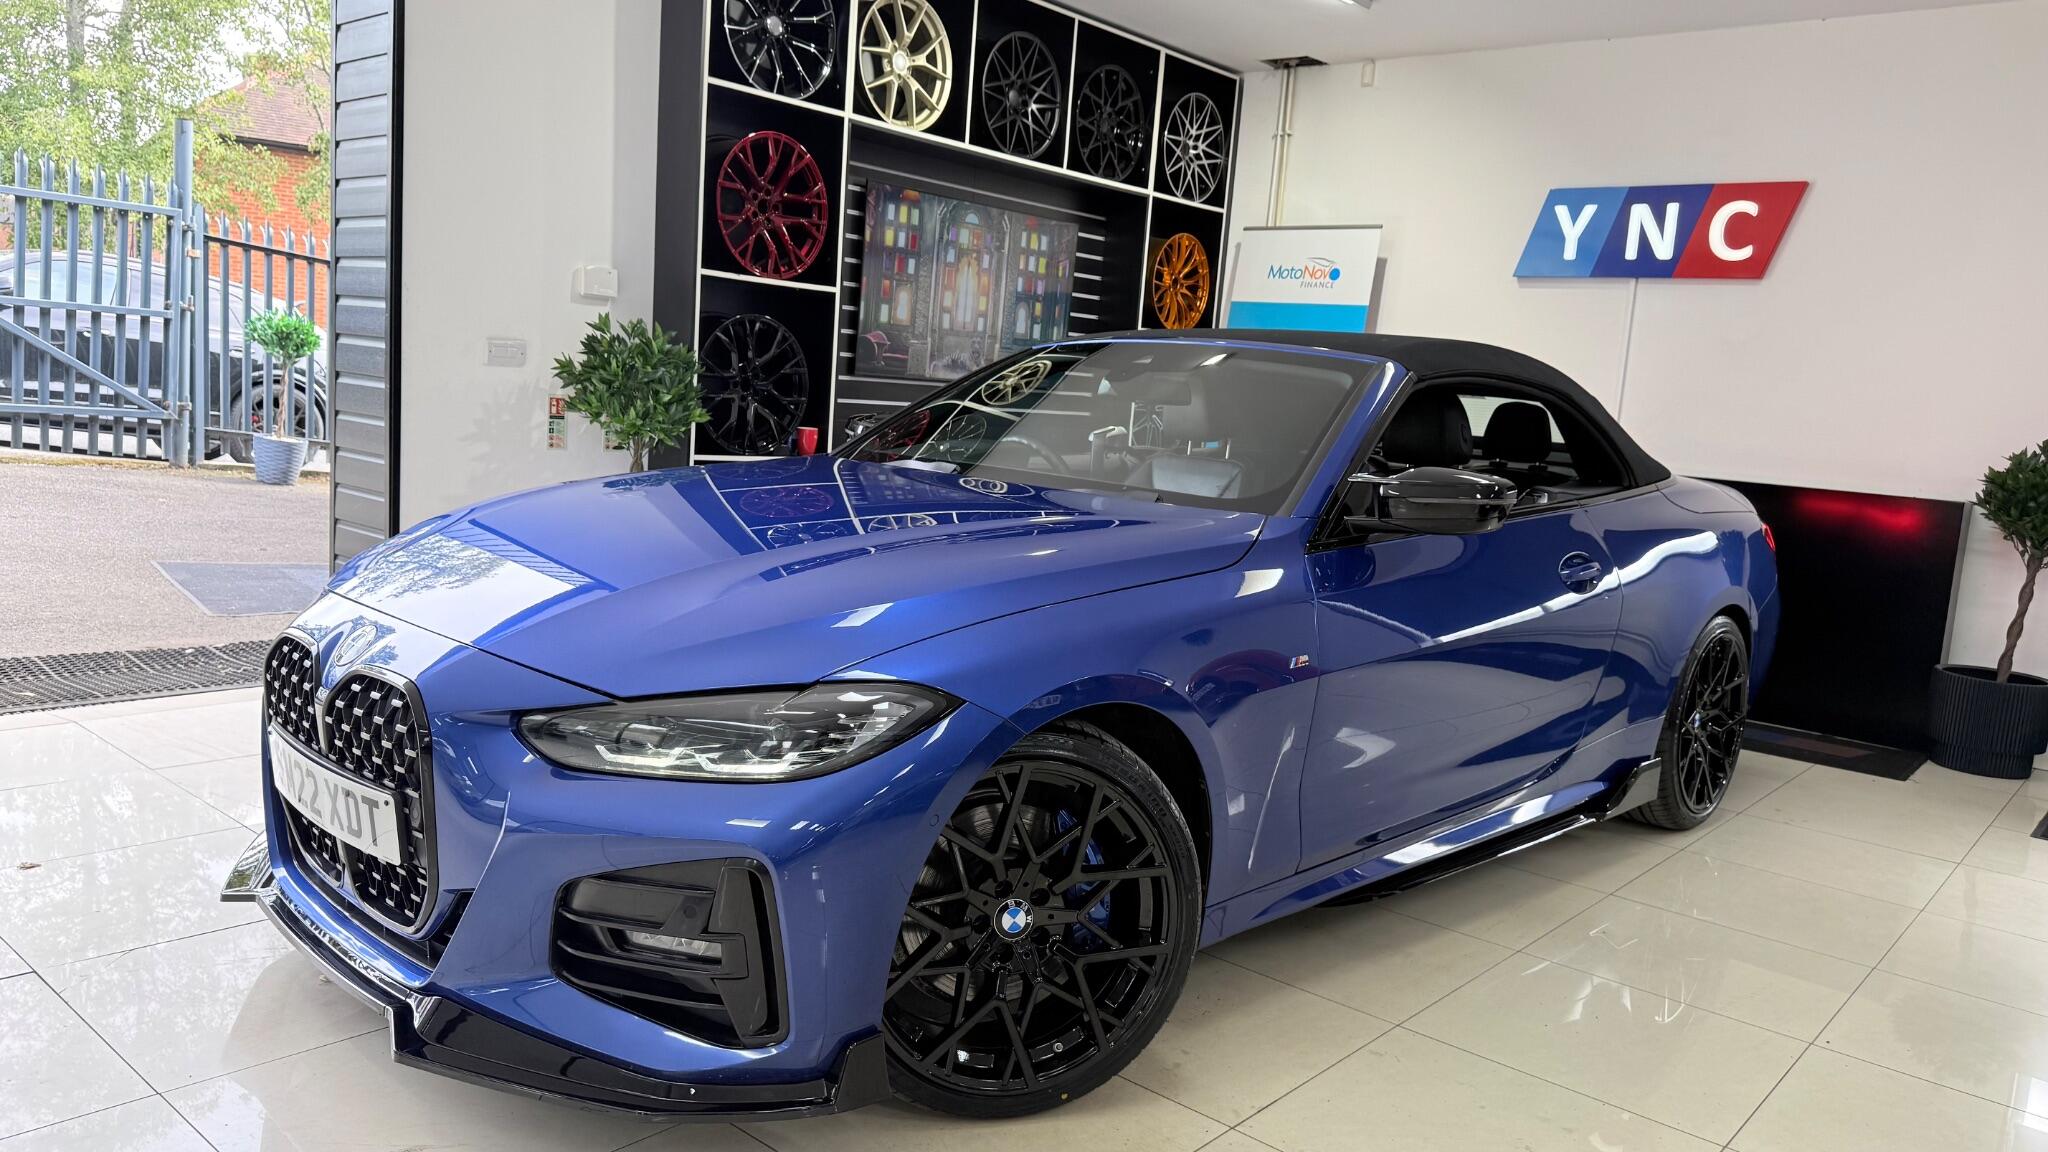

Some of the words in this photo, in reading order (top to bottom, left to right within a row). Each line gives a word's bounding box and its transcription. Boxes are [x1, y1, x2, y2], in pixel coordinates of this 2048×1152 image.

[1554, 200, 1759, 261] YNC
[1300, 281, 1334, 289] FINANCE
[324, 777, 379, 847] XDT
